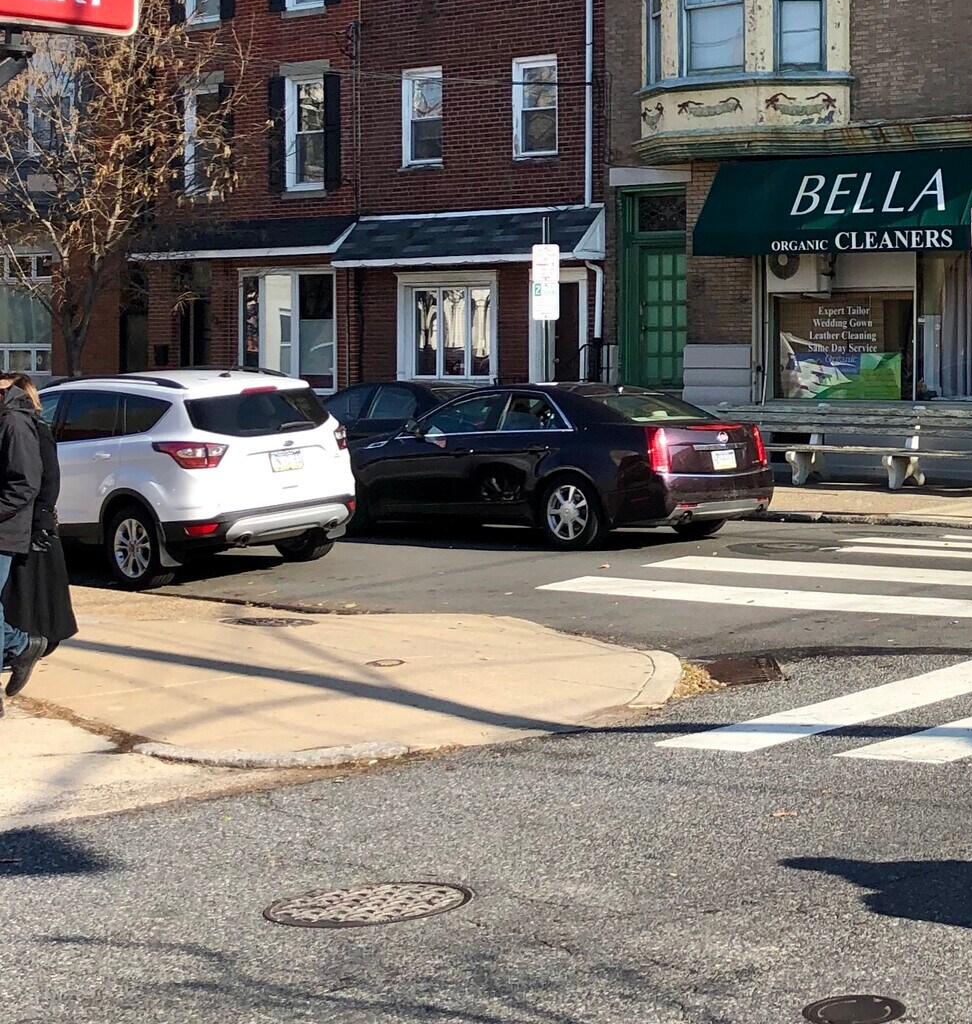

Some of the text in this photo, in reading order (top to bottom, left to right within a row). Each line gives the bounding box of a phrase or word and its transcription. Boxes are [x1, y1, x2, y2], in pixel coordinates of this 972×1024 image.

[790, 168, 946, 216] BELLA
[771, 228, 953, 252] ORGANIC CLEANERS
[818, 306, 870, 317] Expert Tailor
[813, 318, 873, 330] Wedding Gown
[809, 331, 877, 342] Leather Cleaning
[808, 344, 878, 354] Same Day Service
